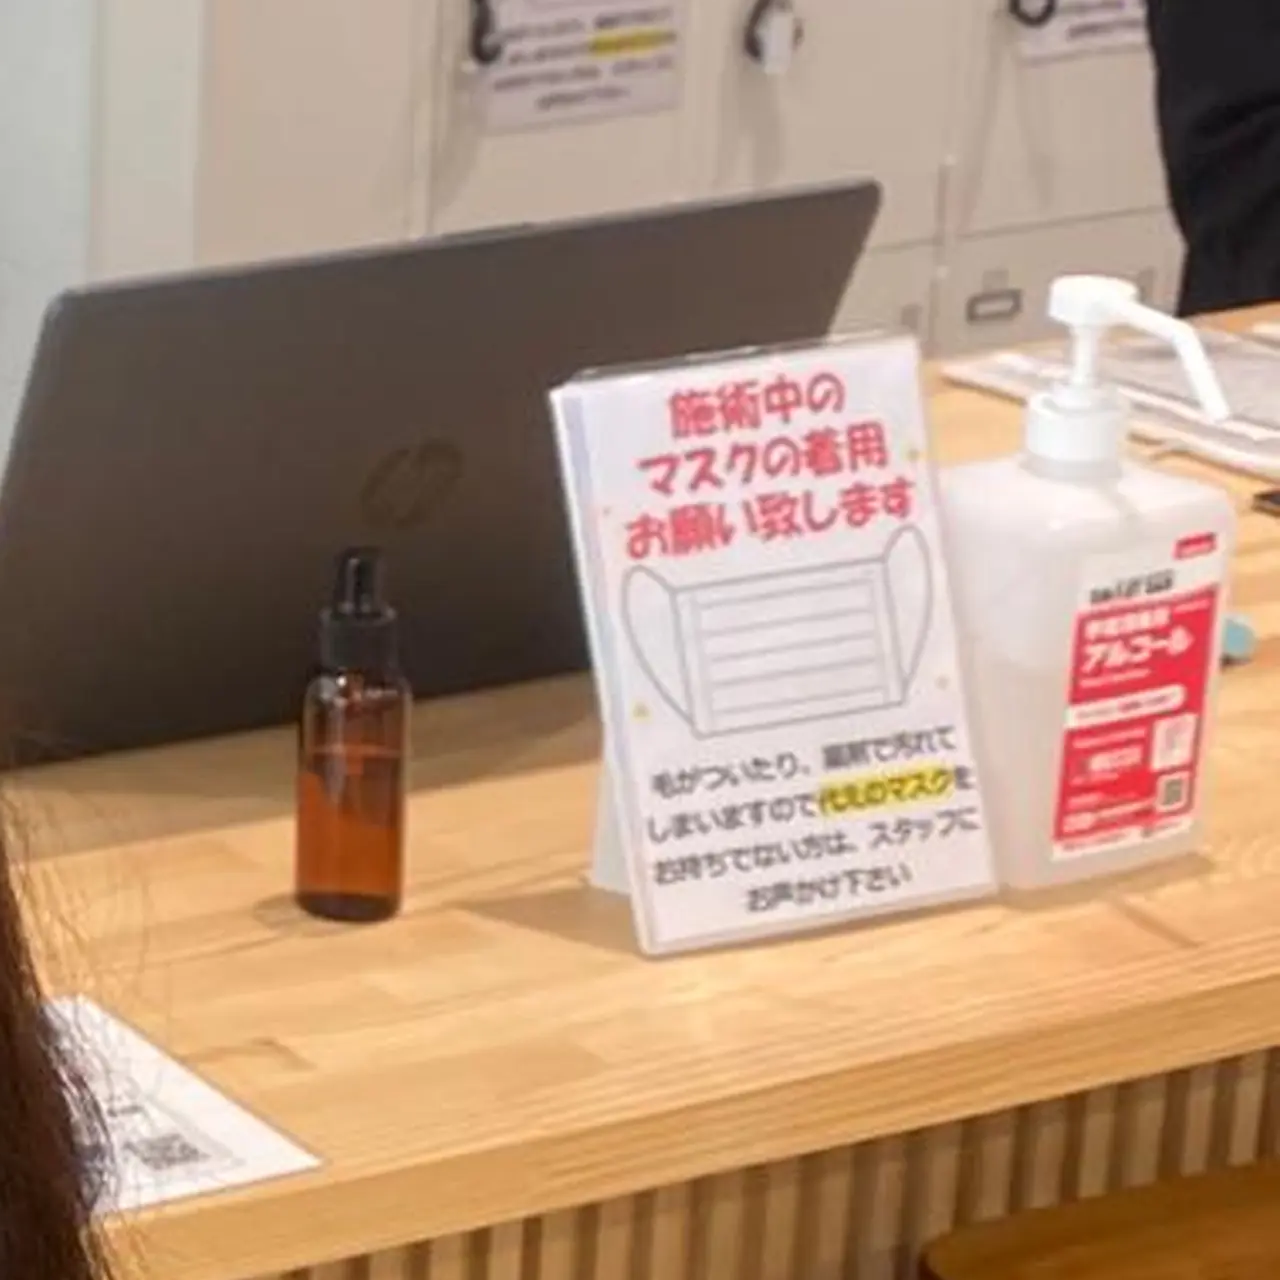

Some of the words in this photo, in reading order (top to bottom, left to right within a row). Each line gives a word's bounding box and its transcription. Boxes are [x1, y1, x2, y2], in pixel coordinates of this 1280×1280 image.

[669, 373, 845, 438] 施術中の
[638, 421, 888, 496] マスクの着用
[626, 477, 914, 559] お願い致します
